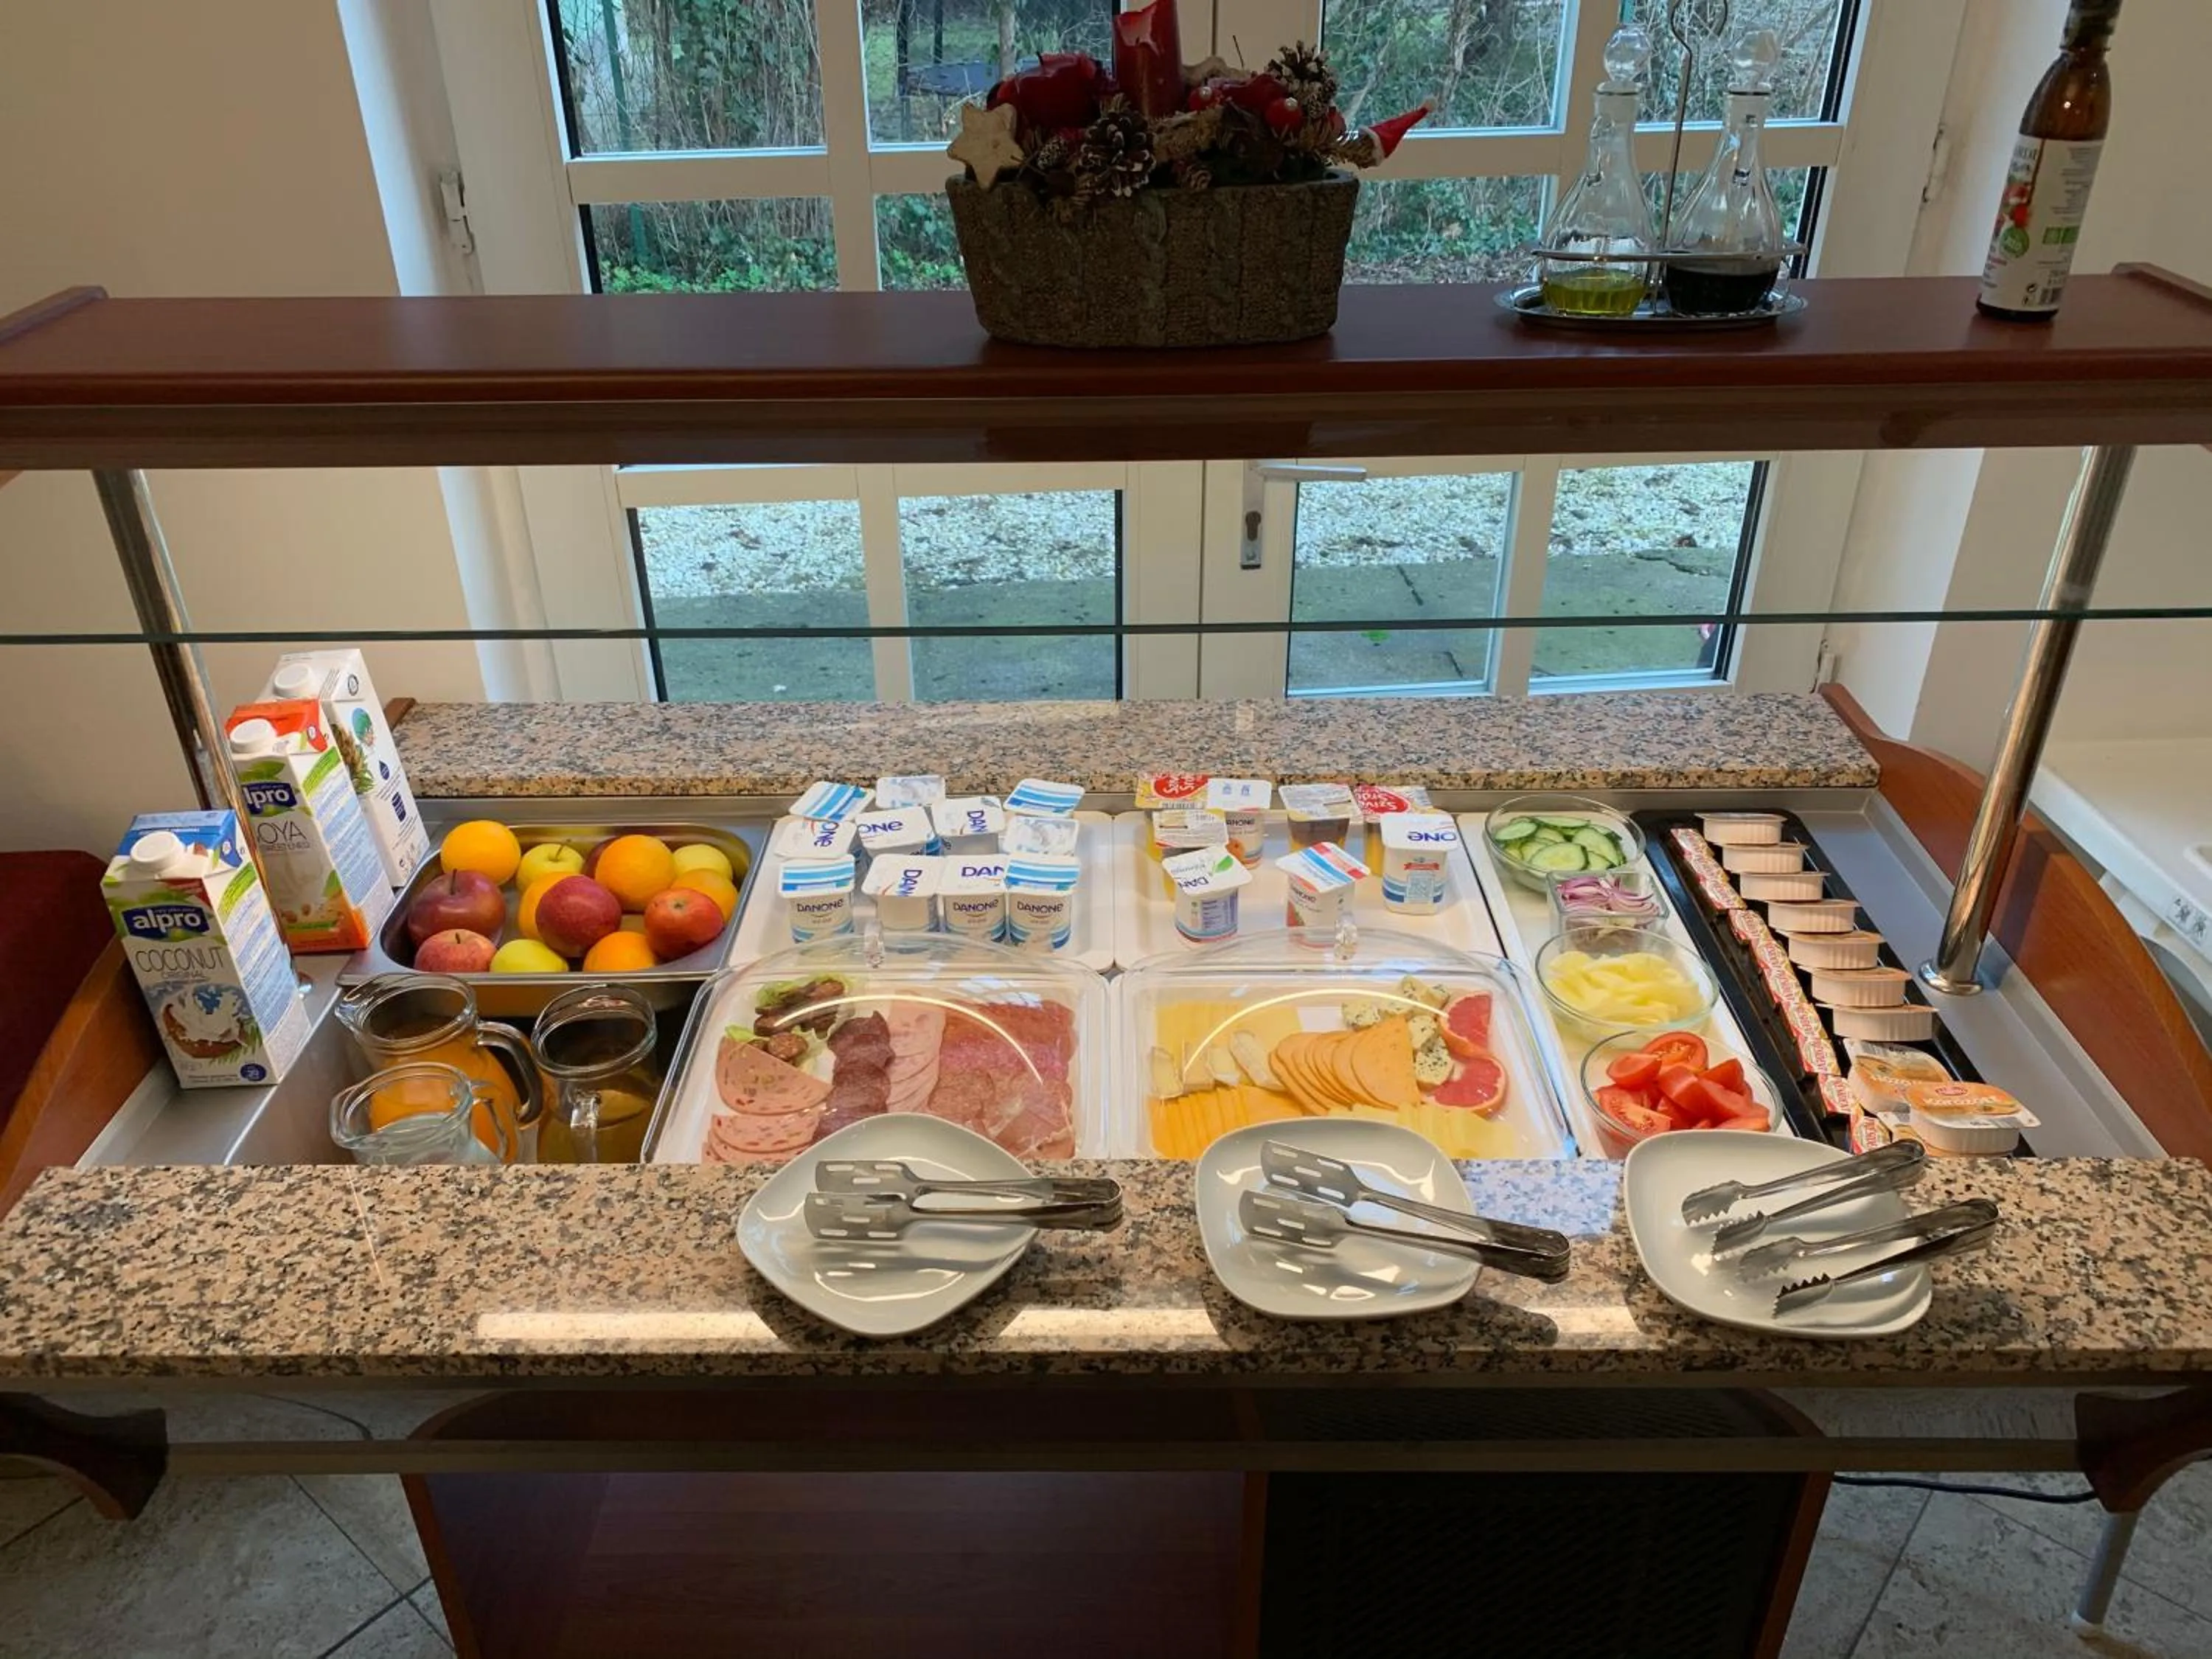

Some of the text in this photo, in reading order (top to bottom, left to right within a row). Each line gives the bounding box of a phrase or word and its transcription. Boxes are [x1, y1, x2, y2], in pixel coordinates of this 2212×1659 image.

[243, 787, 290, 809] lpro
[257, 819, 307, 844] OYA
[132, 909, 201, 933] alpro
[135, 946, 224, 973] COCONUT
